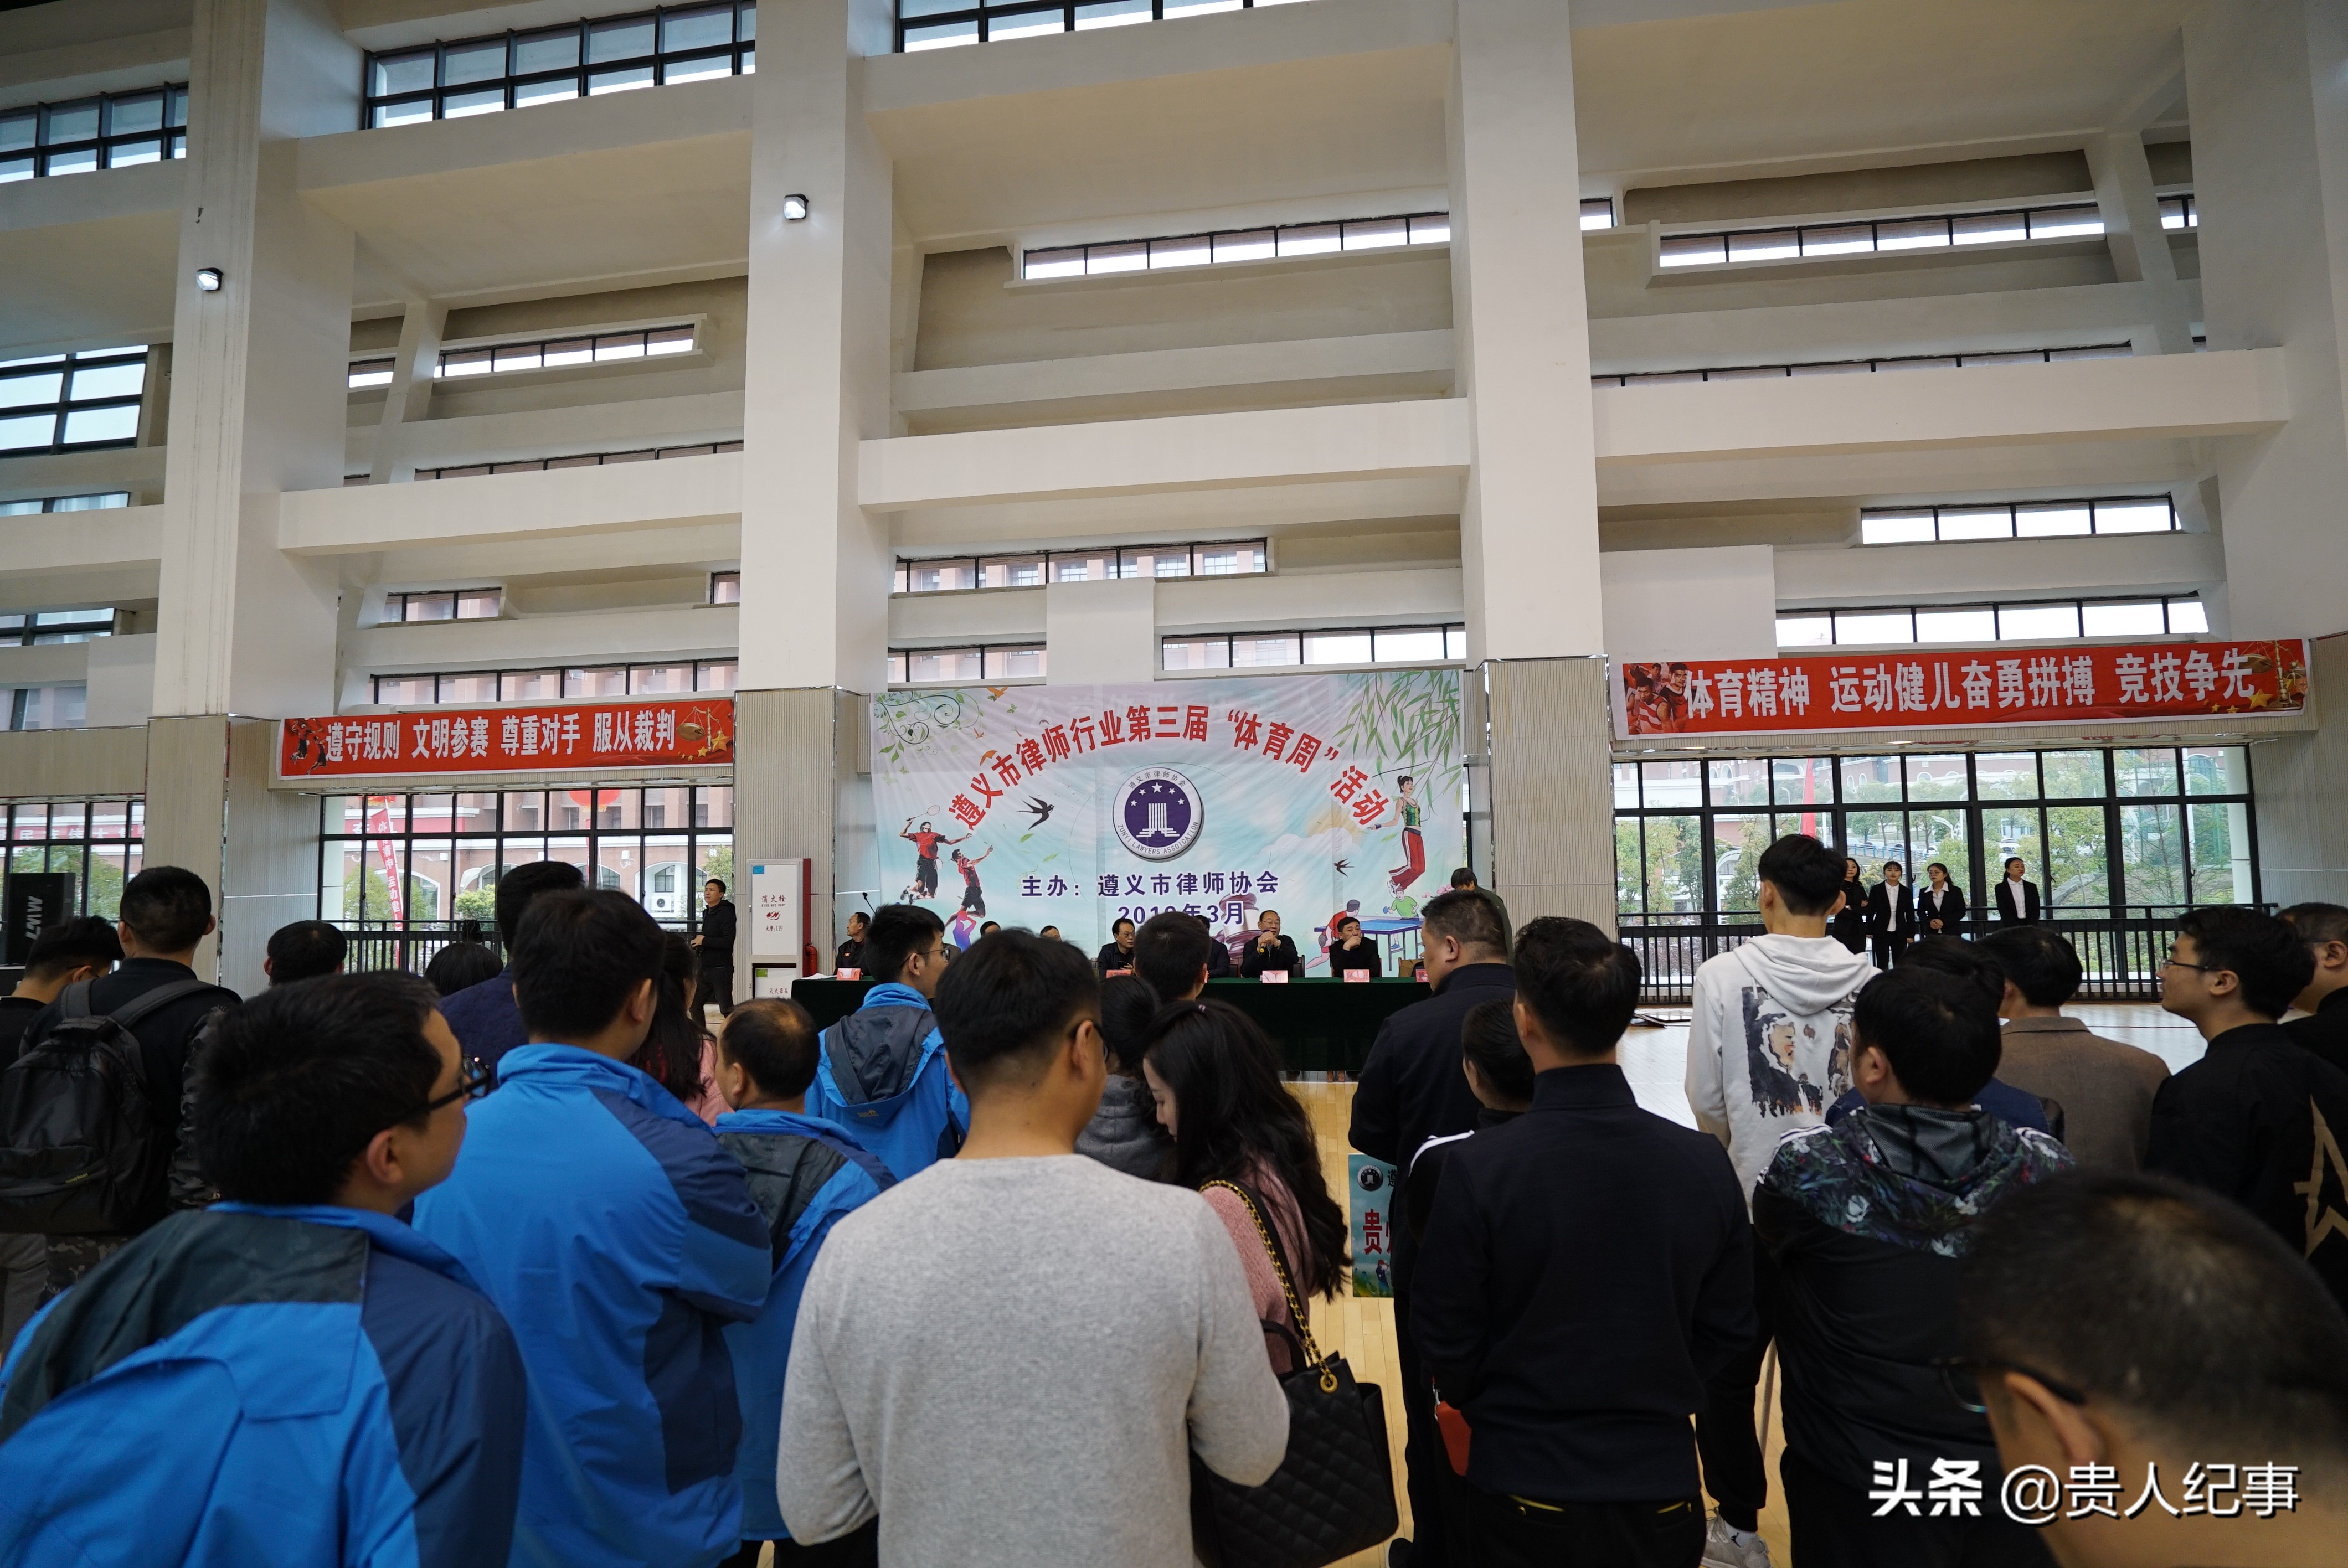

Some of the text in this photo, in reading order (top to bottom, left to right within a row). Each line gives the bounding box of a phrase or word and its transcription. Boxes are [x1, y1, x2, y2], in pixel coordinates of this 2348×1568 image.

[1684, 648, 2254, 719] 体育精神 运动健儿奋勇拼搏 竞技争先
[326, 709, 676, 761] 遵守规则 文明参赛 尊重对手 服从裁判
[1128, 770, 1186, 790] 遵义市律师协会
[1118, 824, 1132, 842] ZUNYI
[1132, 841, 1160, 854] LAWYERS
[1098, 870, 1279, 896] 遵义市律师协会
[761, 895, 786, 903] 消火栓
